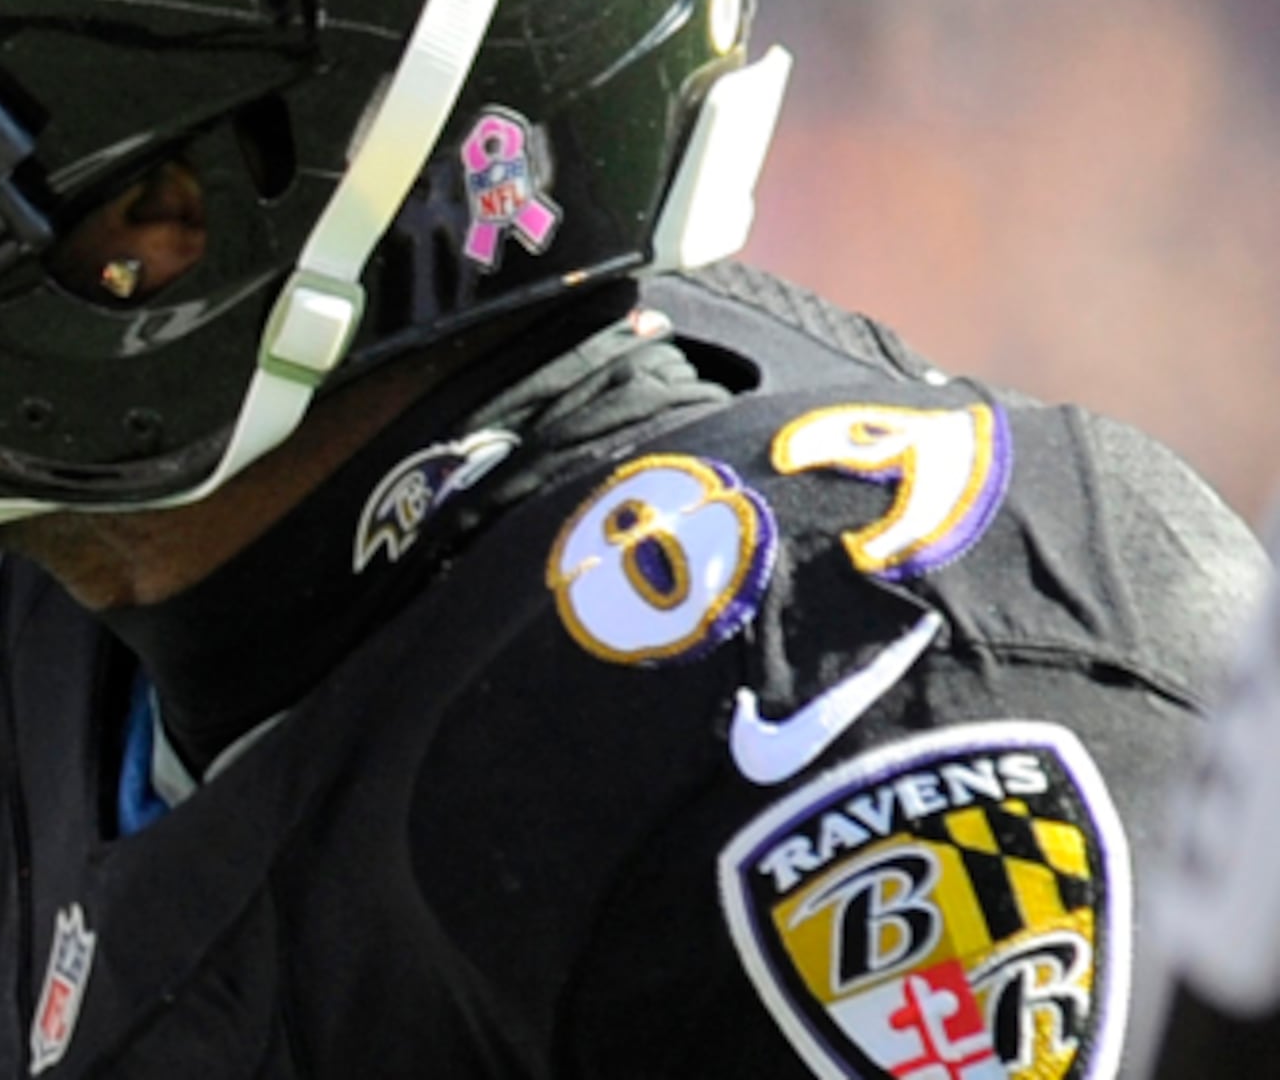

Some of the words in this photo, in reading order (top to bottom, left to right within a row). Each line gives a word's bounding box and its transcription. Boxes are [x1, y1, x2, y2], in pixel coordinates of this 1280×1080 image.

[548, 404, 1012, 666] 89
[758, 754, 1048, 893] RAVENS
[787, 842, 943, 996] B
[966, 928, 1095, 1072] R
